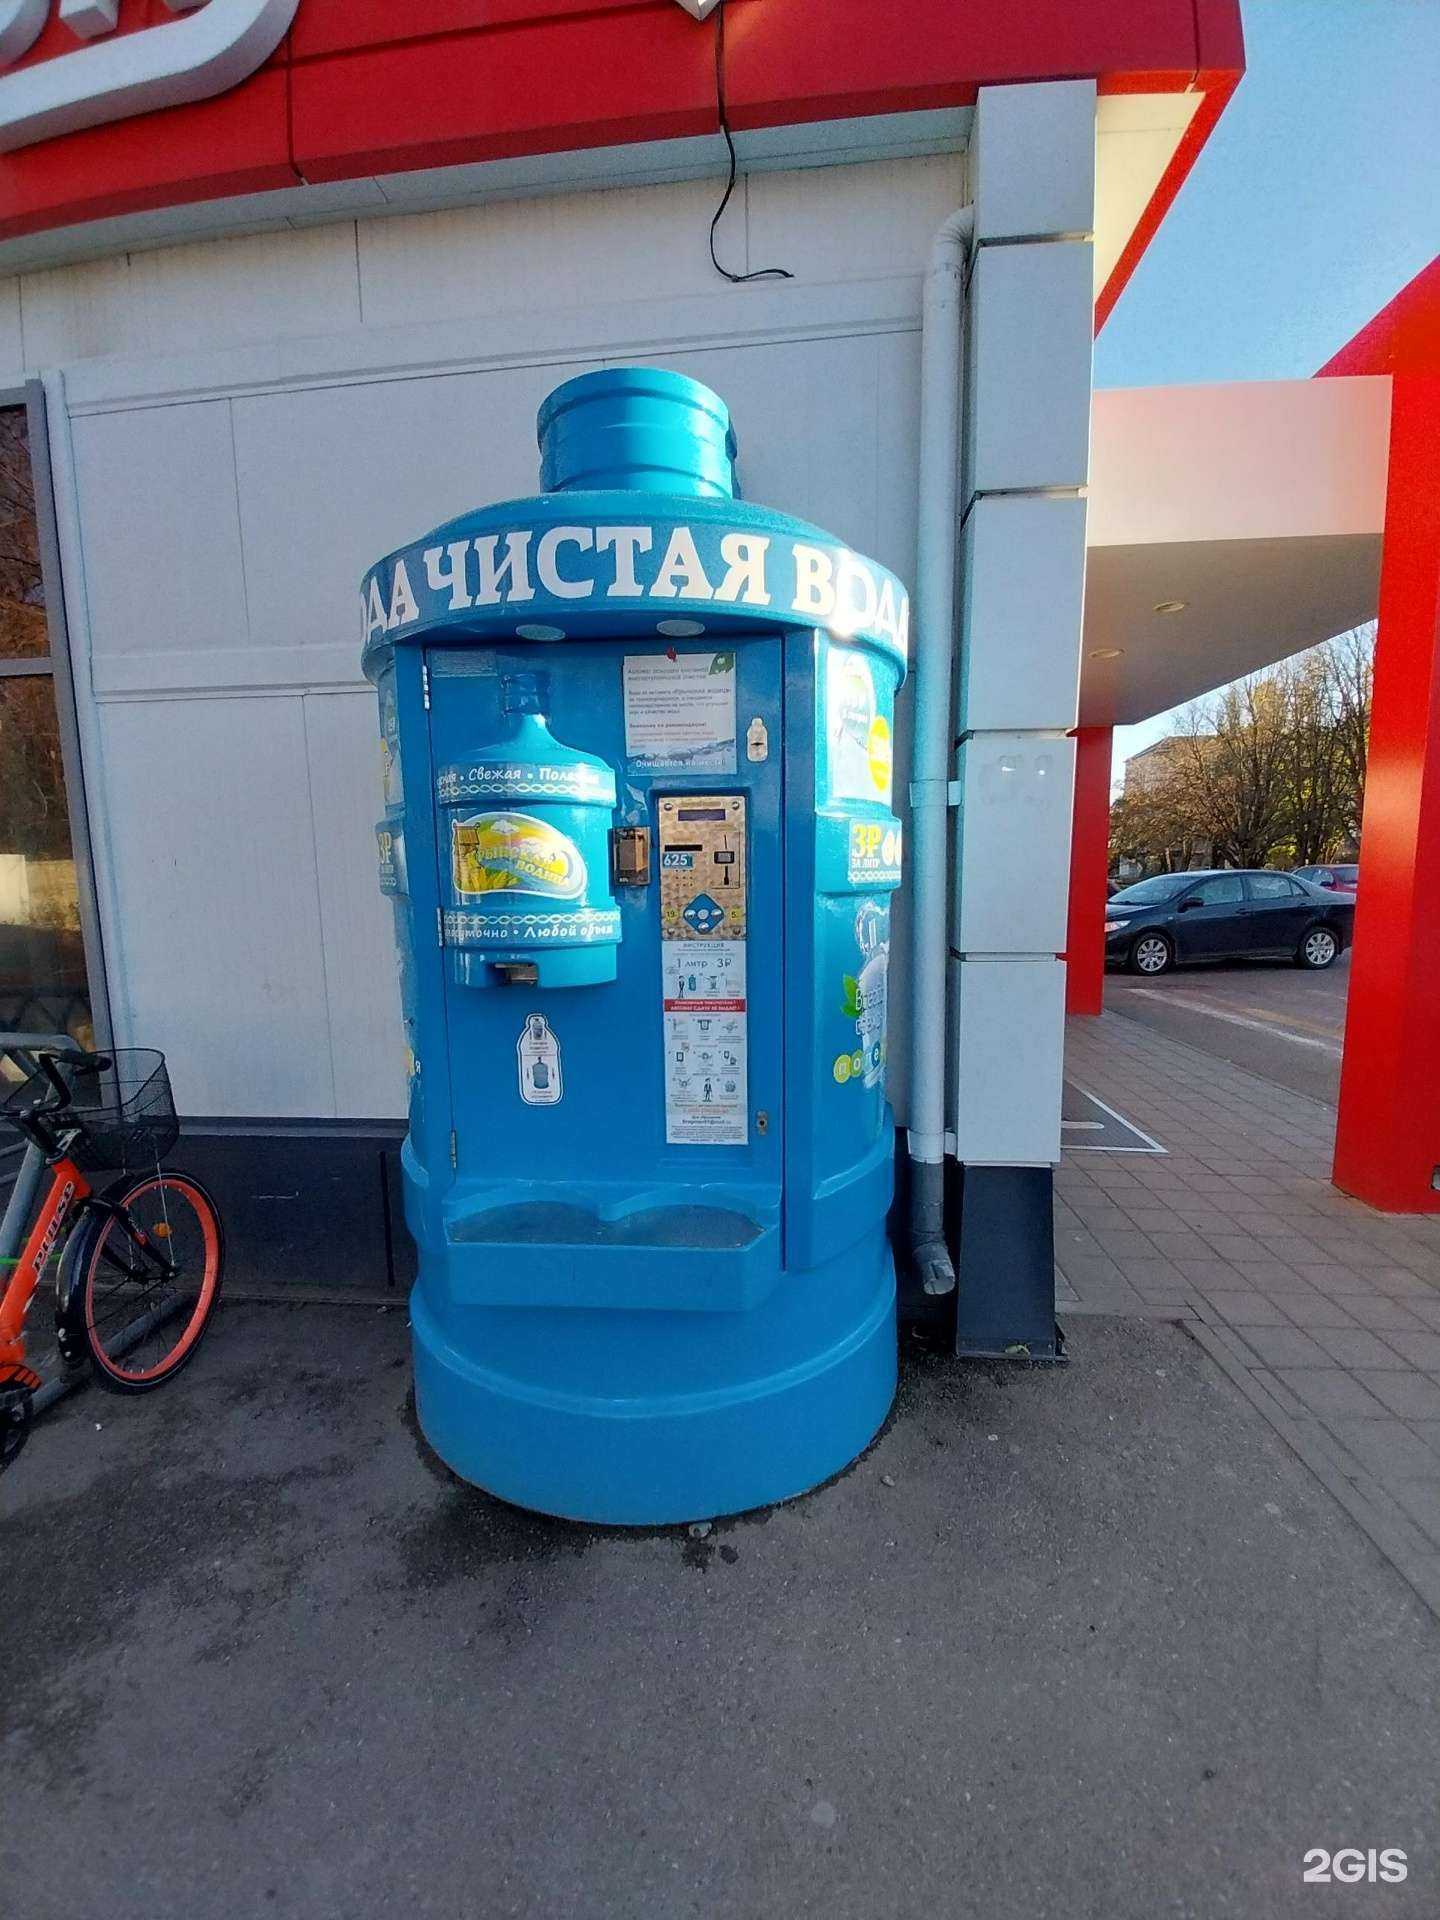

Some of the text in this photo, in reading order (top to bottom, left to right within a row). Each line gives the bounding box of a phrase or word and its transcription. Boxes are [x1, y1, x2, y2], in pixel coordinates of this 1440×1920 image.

[361, 559, 420, 645] ДА
[423, 526, 771, 610] ЧИСТАЯ
[468, 766, 522, 781] Свежая
[663, 854, 688, 866] 625
[524, 924, 577, 938] Любой
